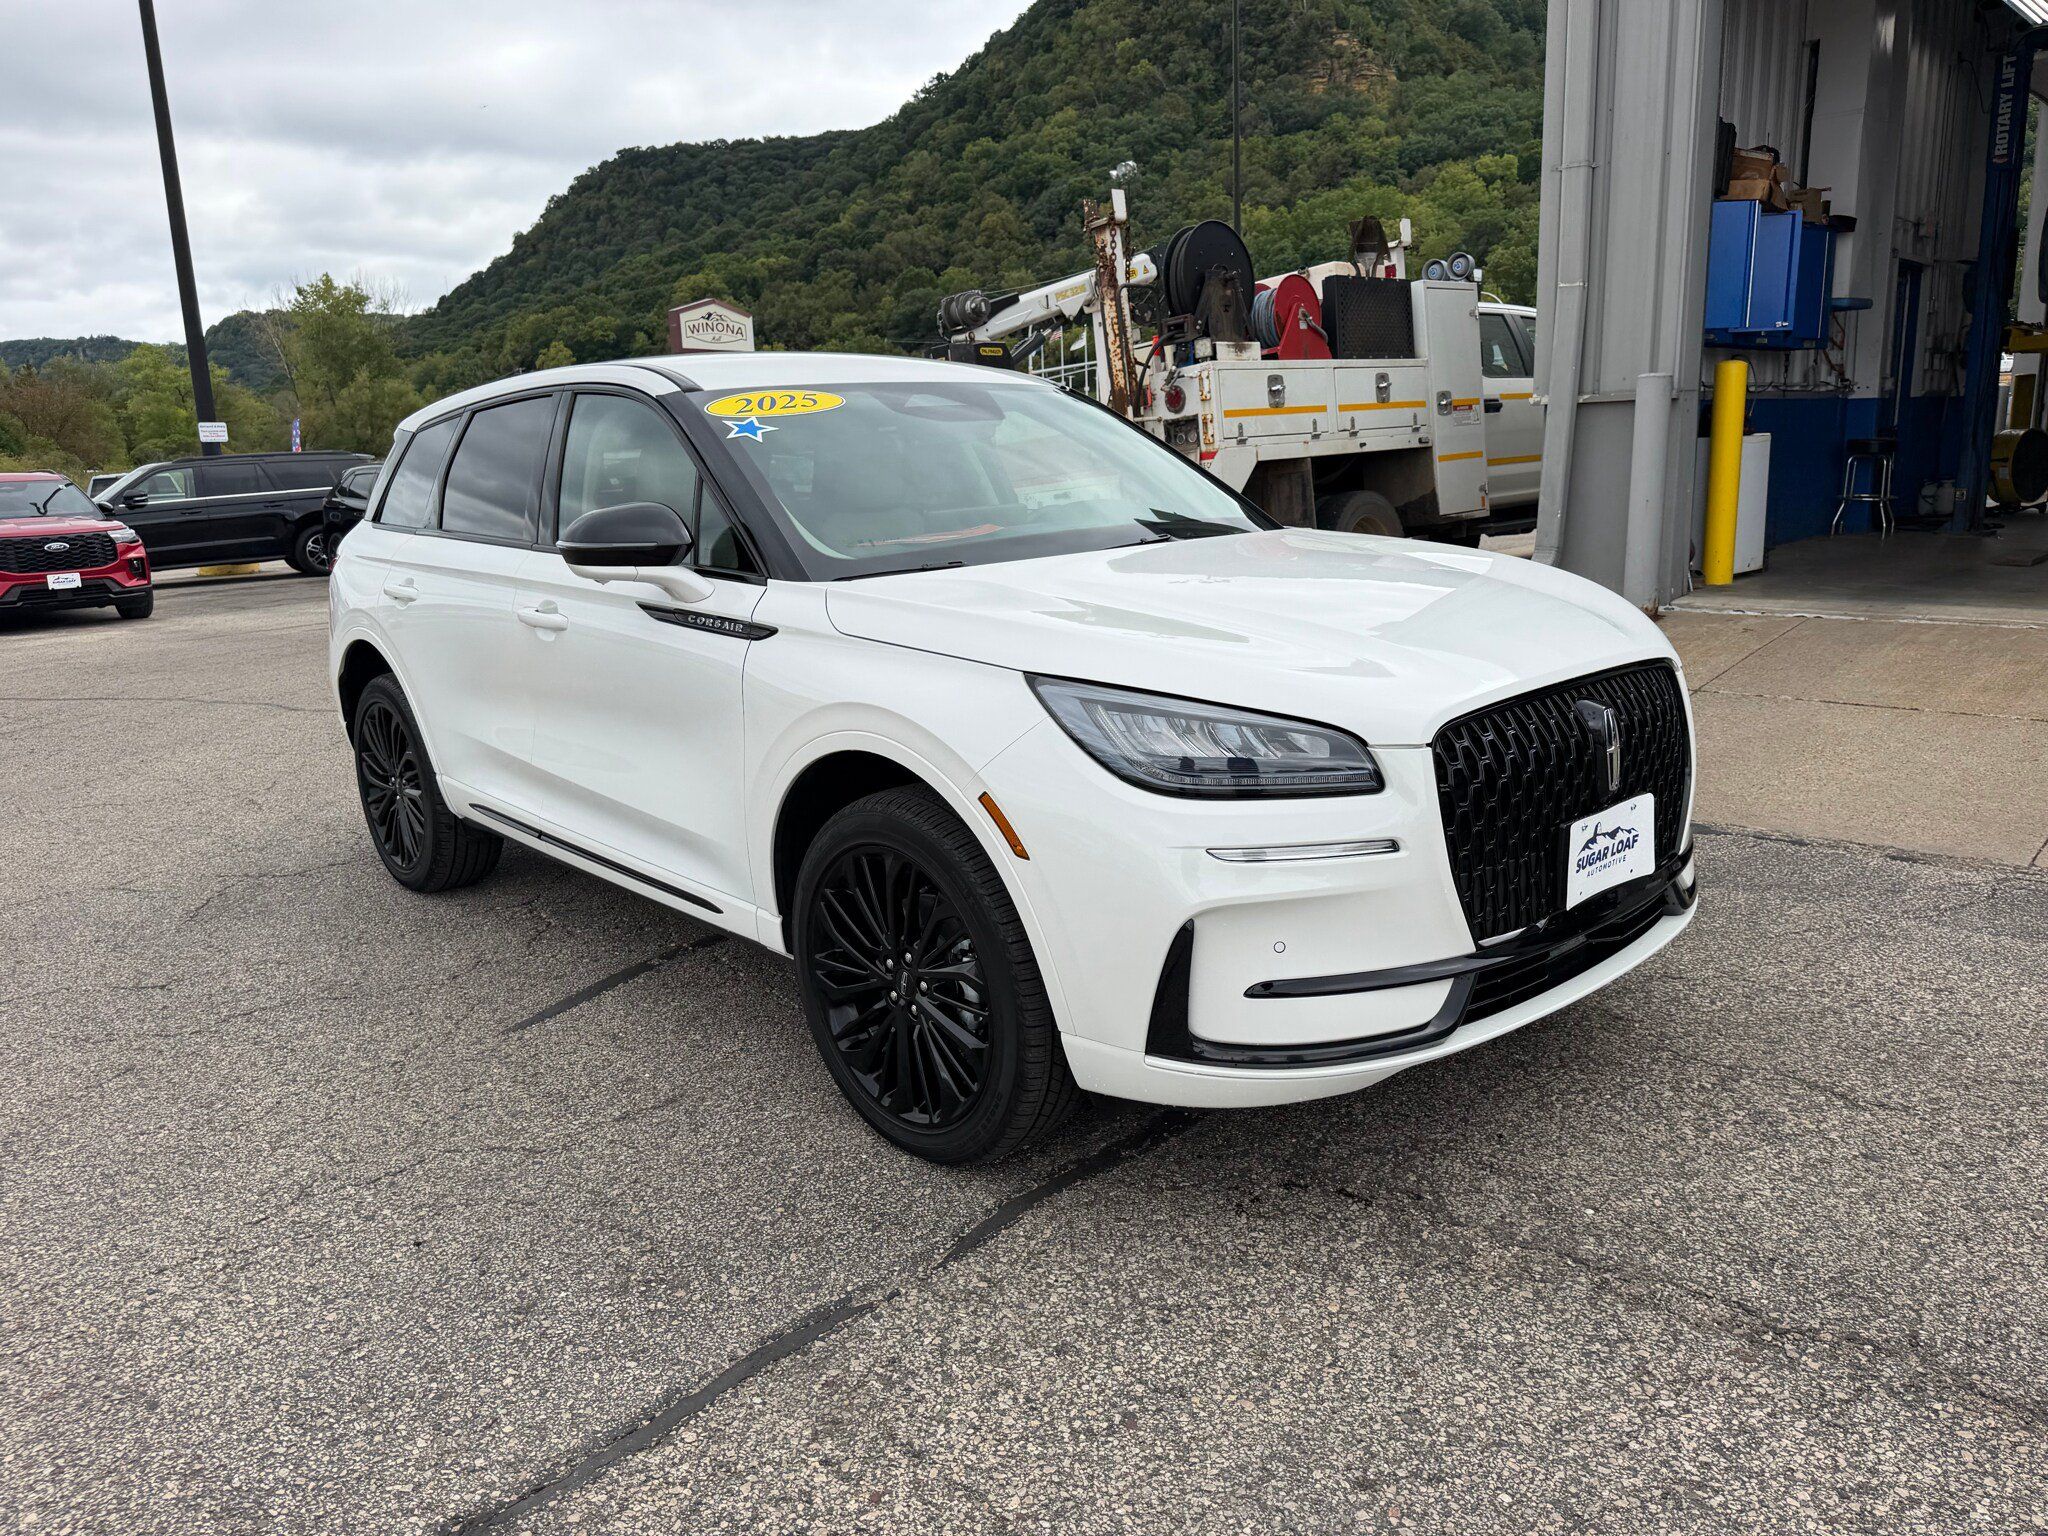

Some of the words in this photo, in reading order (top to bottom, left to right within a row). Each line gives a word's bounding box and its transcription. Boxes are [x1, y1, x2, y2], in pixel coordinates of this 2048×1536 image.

[2000, 55, 2017, 88] LIFT
[1994, 93, 2013, 156] ROTARY
[687, 322, 744, 338] WINONA
[734, 393, 818, 415] 2025
[687, 614, 744, 632] CORSAIR
[1575, 846, 1610, 874] SUGAR
[1610, 834, 1640, 858] LOAF
[1586, 854, 1627, 878] AUTOMOTIVE
